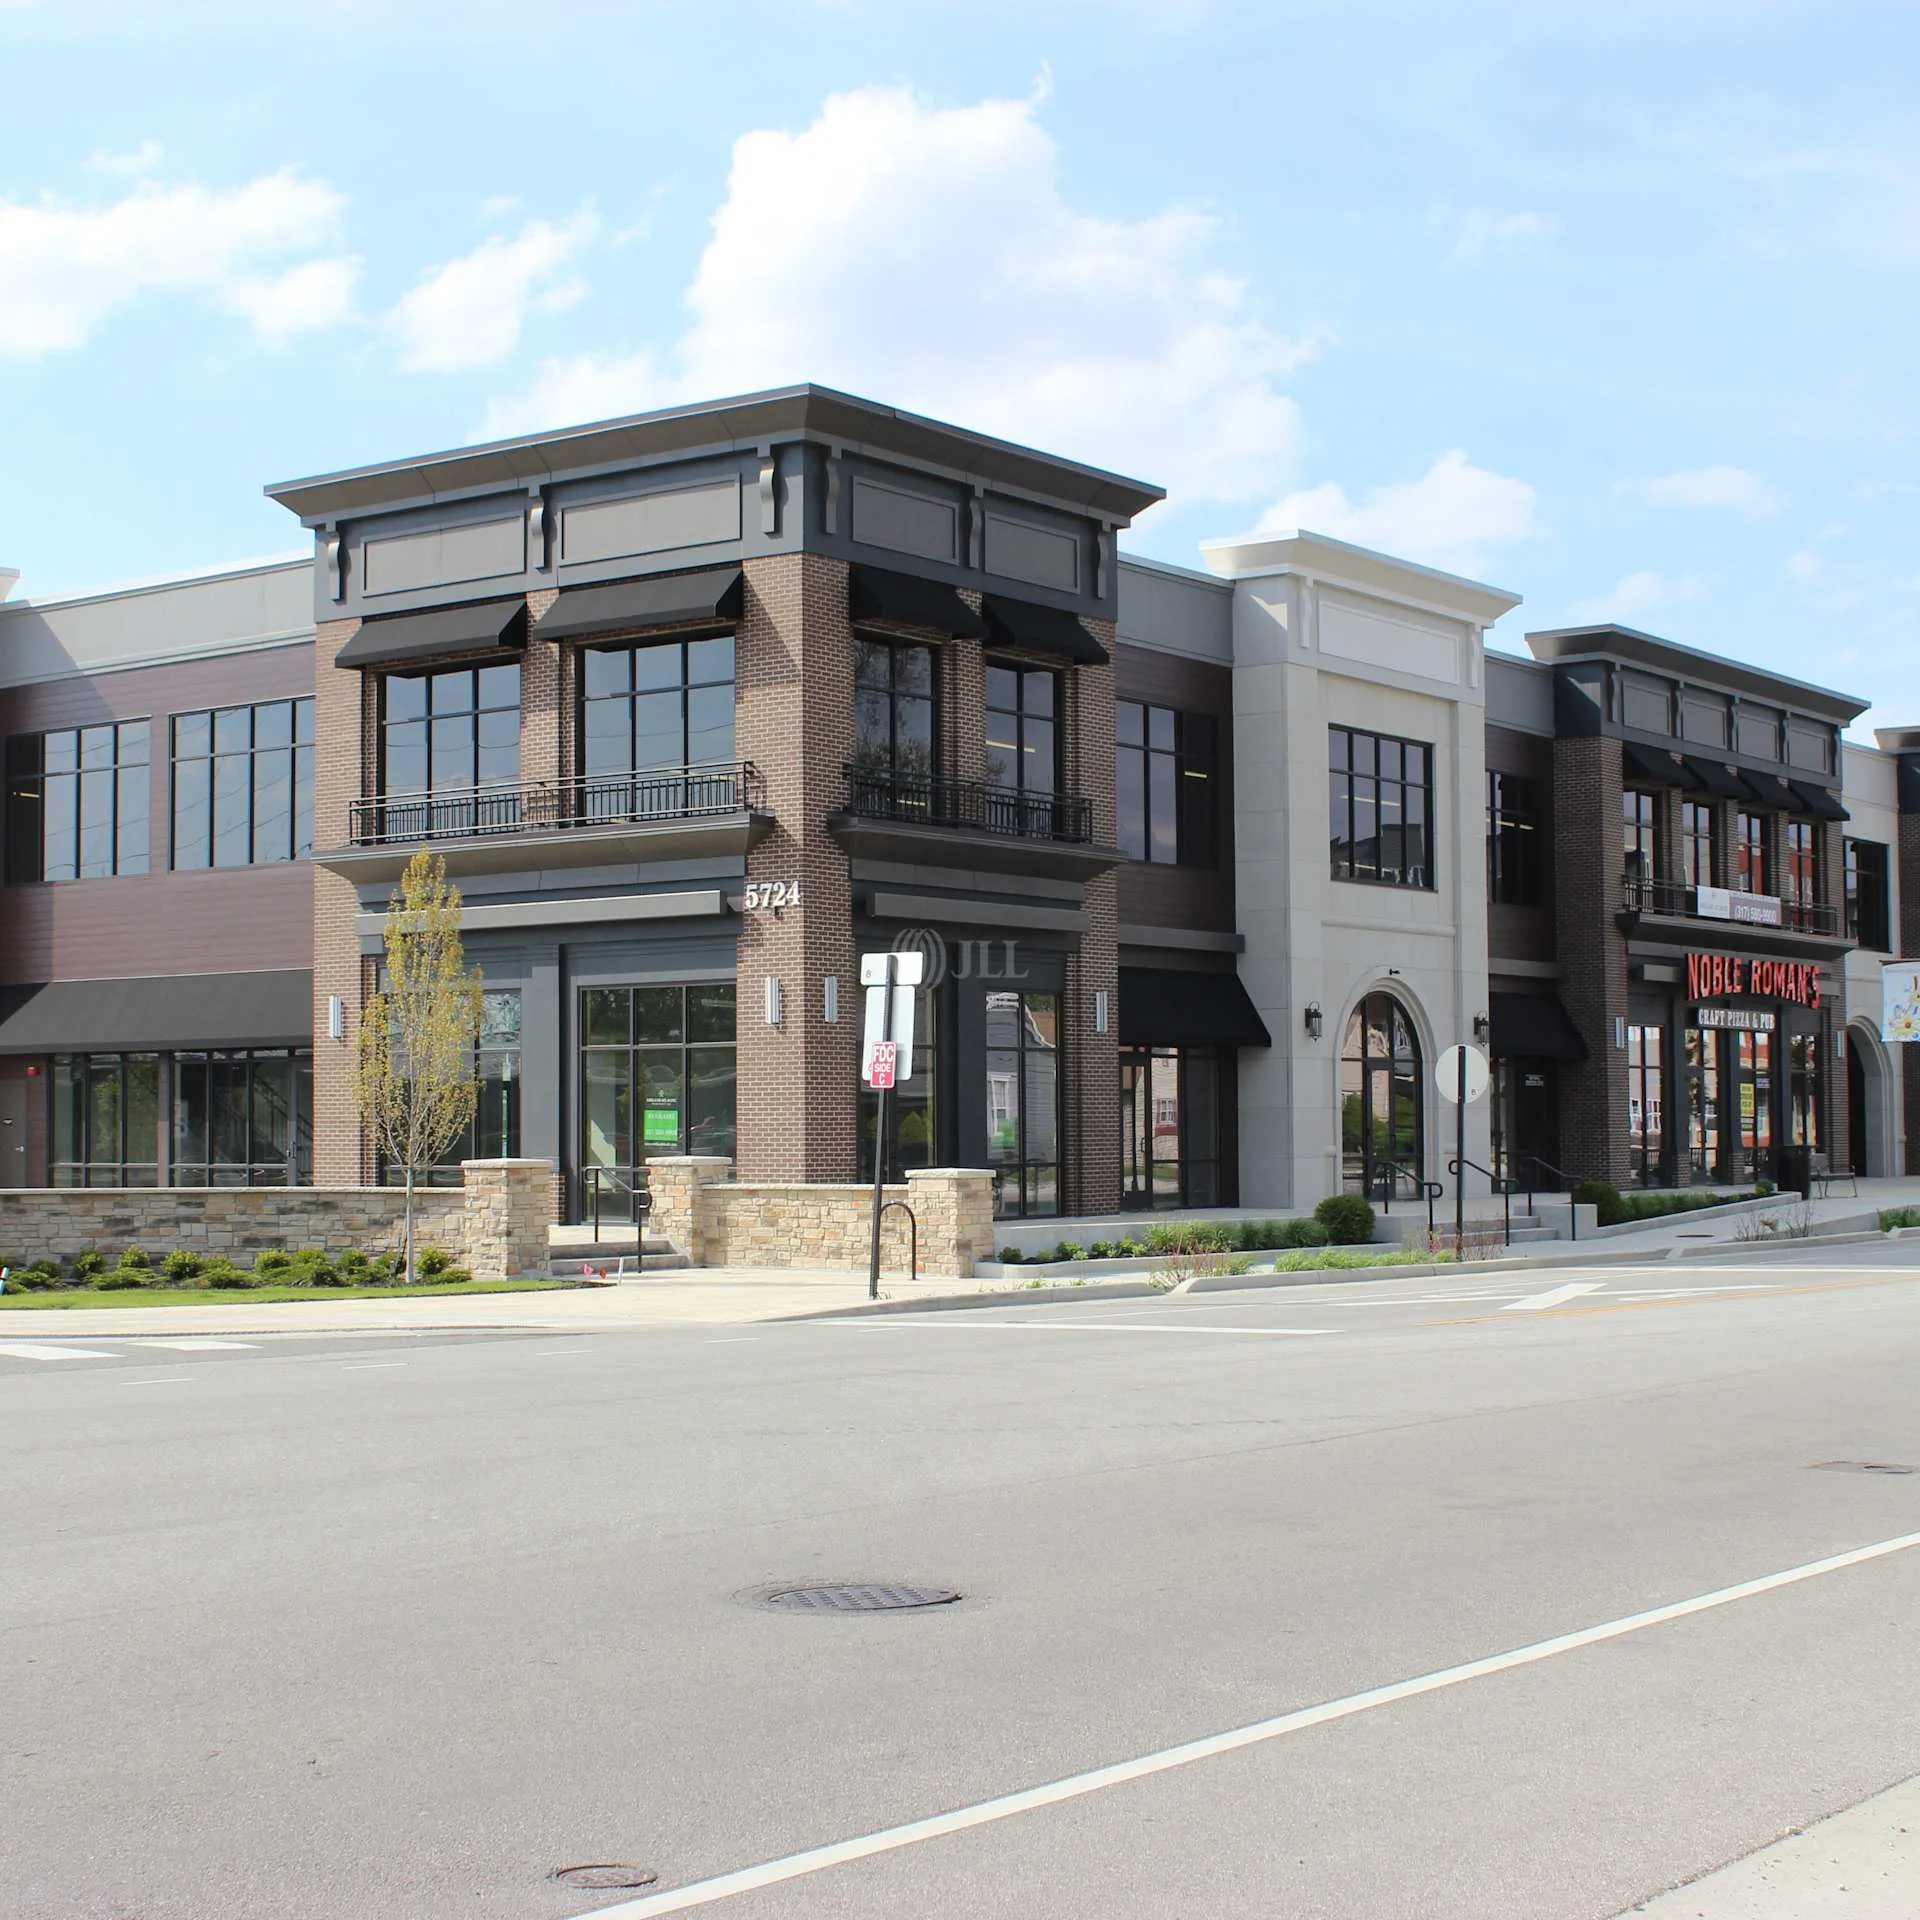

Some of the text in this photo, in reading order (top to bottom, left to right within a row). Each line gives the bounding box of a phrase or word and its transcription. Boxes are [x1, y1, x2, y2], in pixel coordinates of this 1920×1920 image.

[745, 880, 801, 909] 5724
[1687, 952, 1822, 1009] NOBLE ROMAN'S
[1698, 1008, 1725, 1026] CRAFT
[1727, 1010, 1751, 1028] PIZZA
[1760, 1013, 1776, 1030] PUB
[873, 1044, 894, 1063] FDC
[874, 1063, 892, 1073] SIDE
[879, 1072, 886, 1085] C
